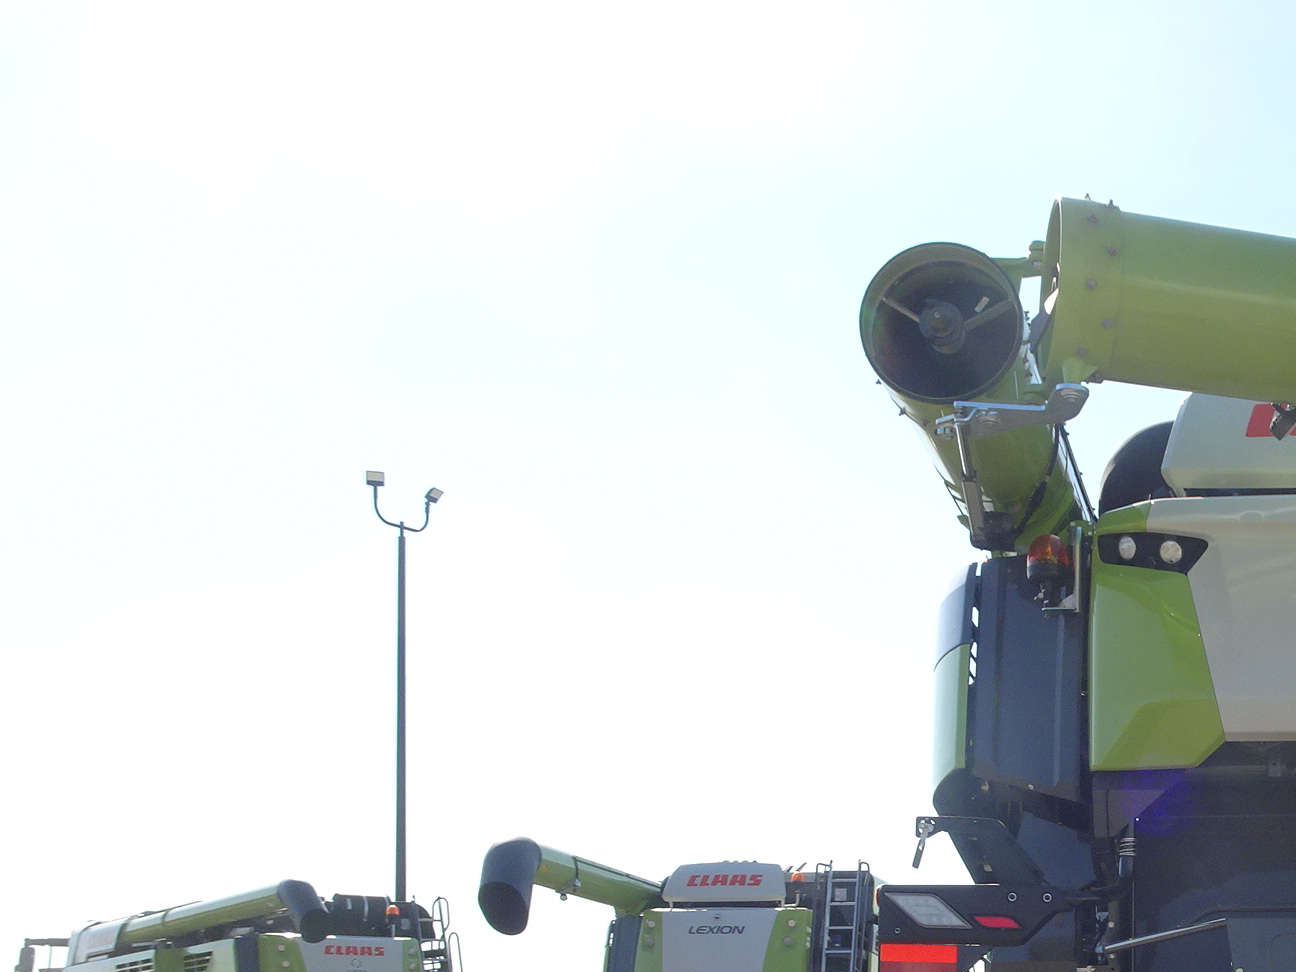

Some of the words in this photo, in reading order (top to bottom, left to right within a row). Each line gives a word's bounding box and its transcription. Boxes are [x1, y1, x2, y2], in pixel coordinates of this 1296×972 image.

[685, 874, 763, 887] CLAAS
[688, 925, 746, 935] LEXION
[324, 945, 385, 957] CLAAS
